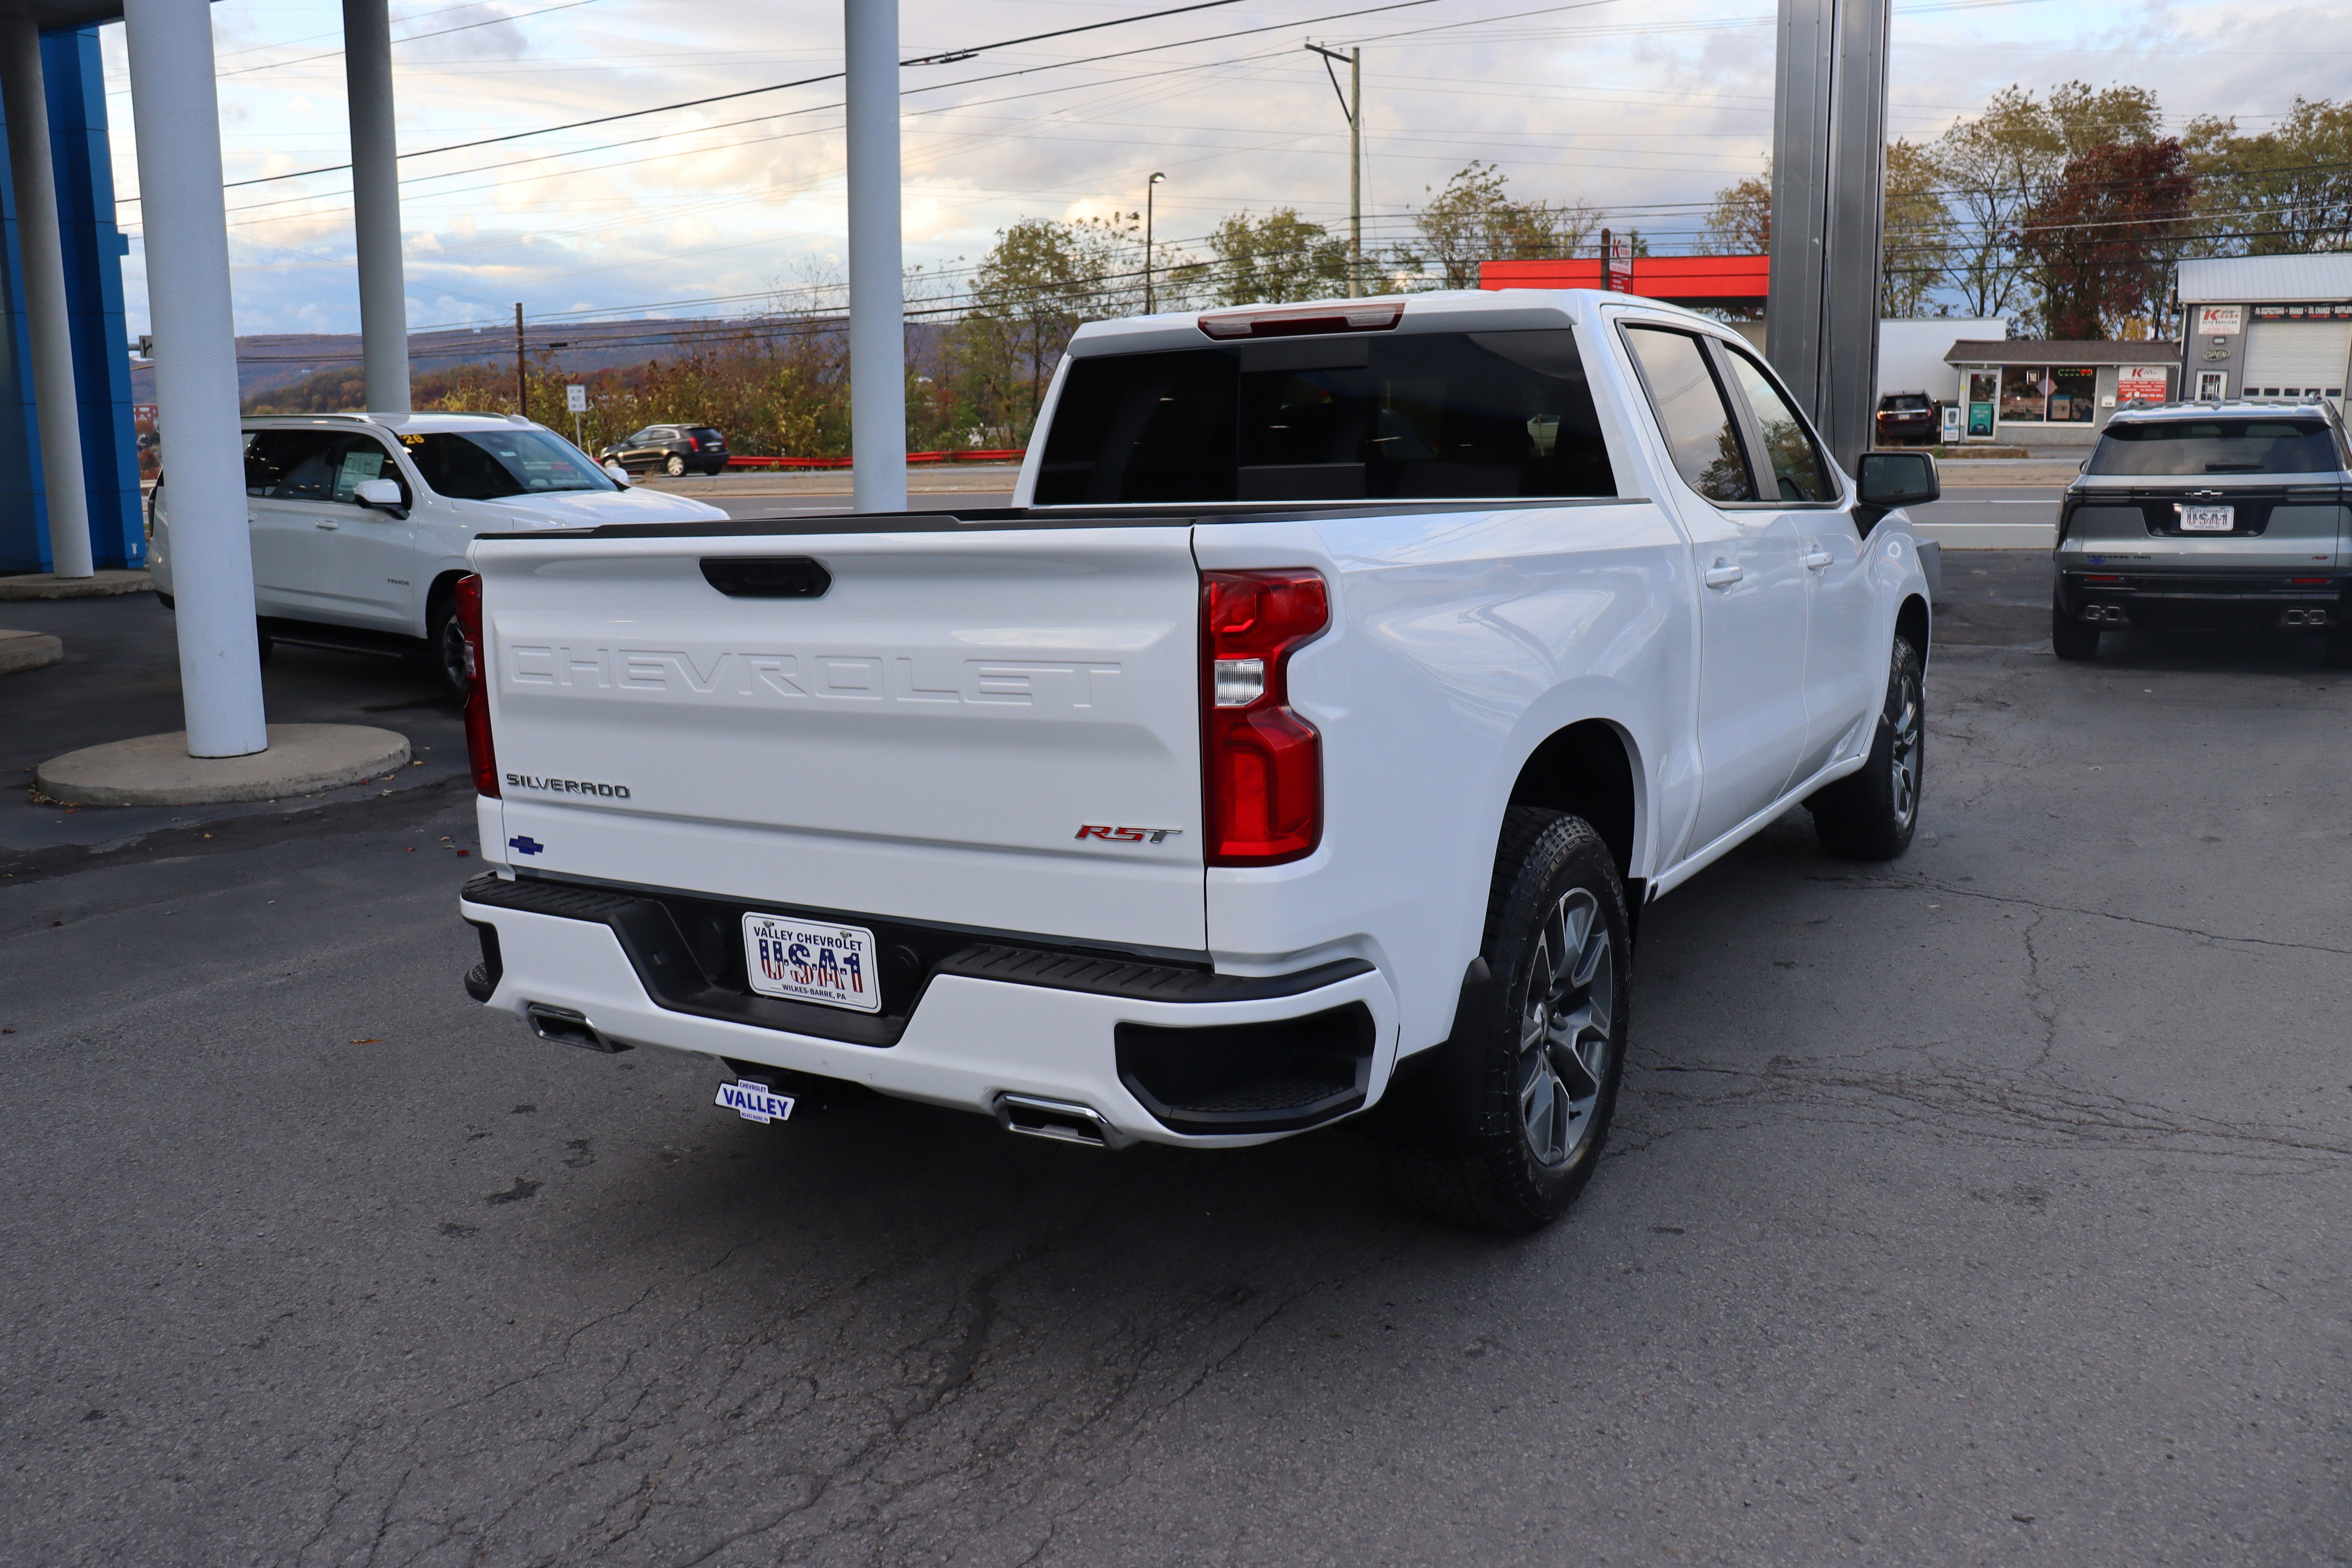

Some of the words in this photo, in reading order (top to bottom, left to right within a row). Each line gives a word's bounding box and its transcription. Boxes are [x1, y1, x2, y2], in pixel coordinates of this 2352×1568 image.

[2205, 351, 2227, 359] OPEN
[387, 578, 410, 586] TAHOE
[511, 645, 1121, 708] CHEVROLET
[506, 773, 631, 798] SILVERADO
[1074, 824, 1183, 843] RST
[753, 926, 793, 941] VALLEY
[796, 932, 862, 952] CHEVROLET
[782, 984, 835, 1000] WILKES-BARRE,
[837, 992, 846, 1000] PA
[739, 1082, 767, 1093] CHEVROLET
[723, 1087, 788, 1118] VALLEY
